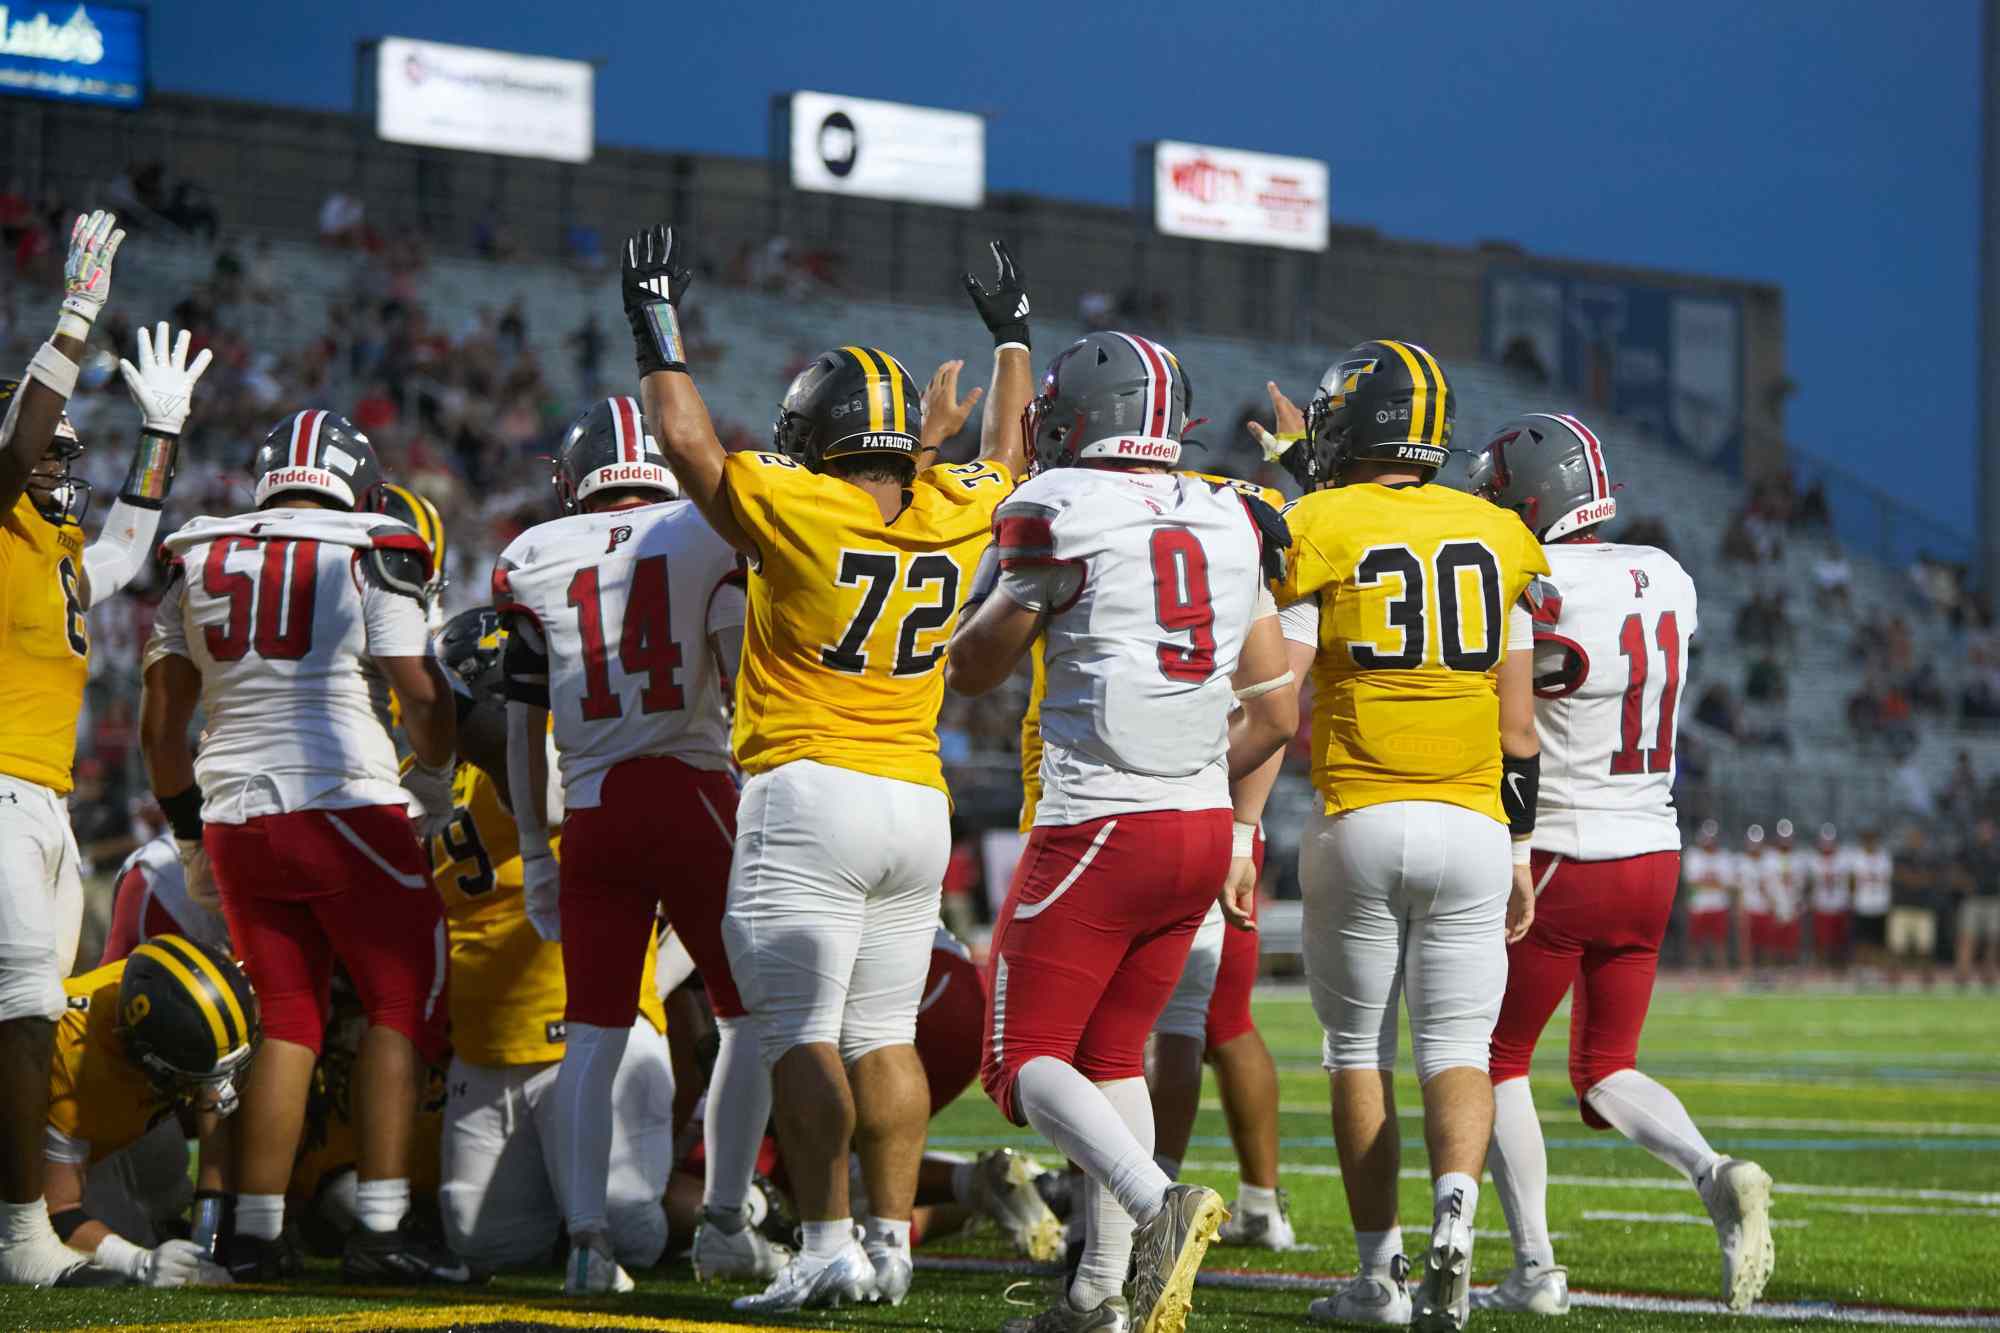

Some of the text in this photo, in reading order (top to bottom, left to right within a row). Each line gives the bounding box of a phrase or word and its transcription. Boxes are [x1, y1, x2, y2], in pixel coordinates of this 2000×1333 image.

[268, 470, 331, 488] Riddell
[600, 466, 663, 483] Riddell
[862, 435, 913, 451] PATRIOTS
[1118, 439, 1178, 459] Riddell
[1396, 446, 1445, 463] PATRIOTS
[1576, 502, 1616, 525] Ridde
[202, 535, 320, 662] 50
[566, 554, 685, 722] 14
[819, 548, 961, 678] 72
[1149, 527, 1217, 686] 9
[1347, 540, 1503, 672] 30
[1610, 610, 1680, 776] 11
[431, 806, 496, 895] 9
